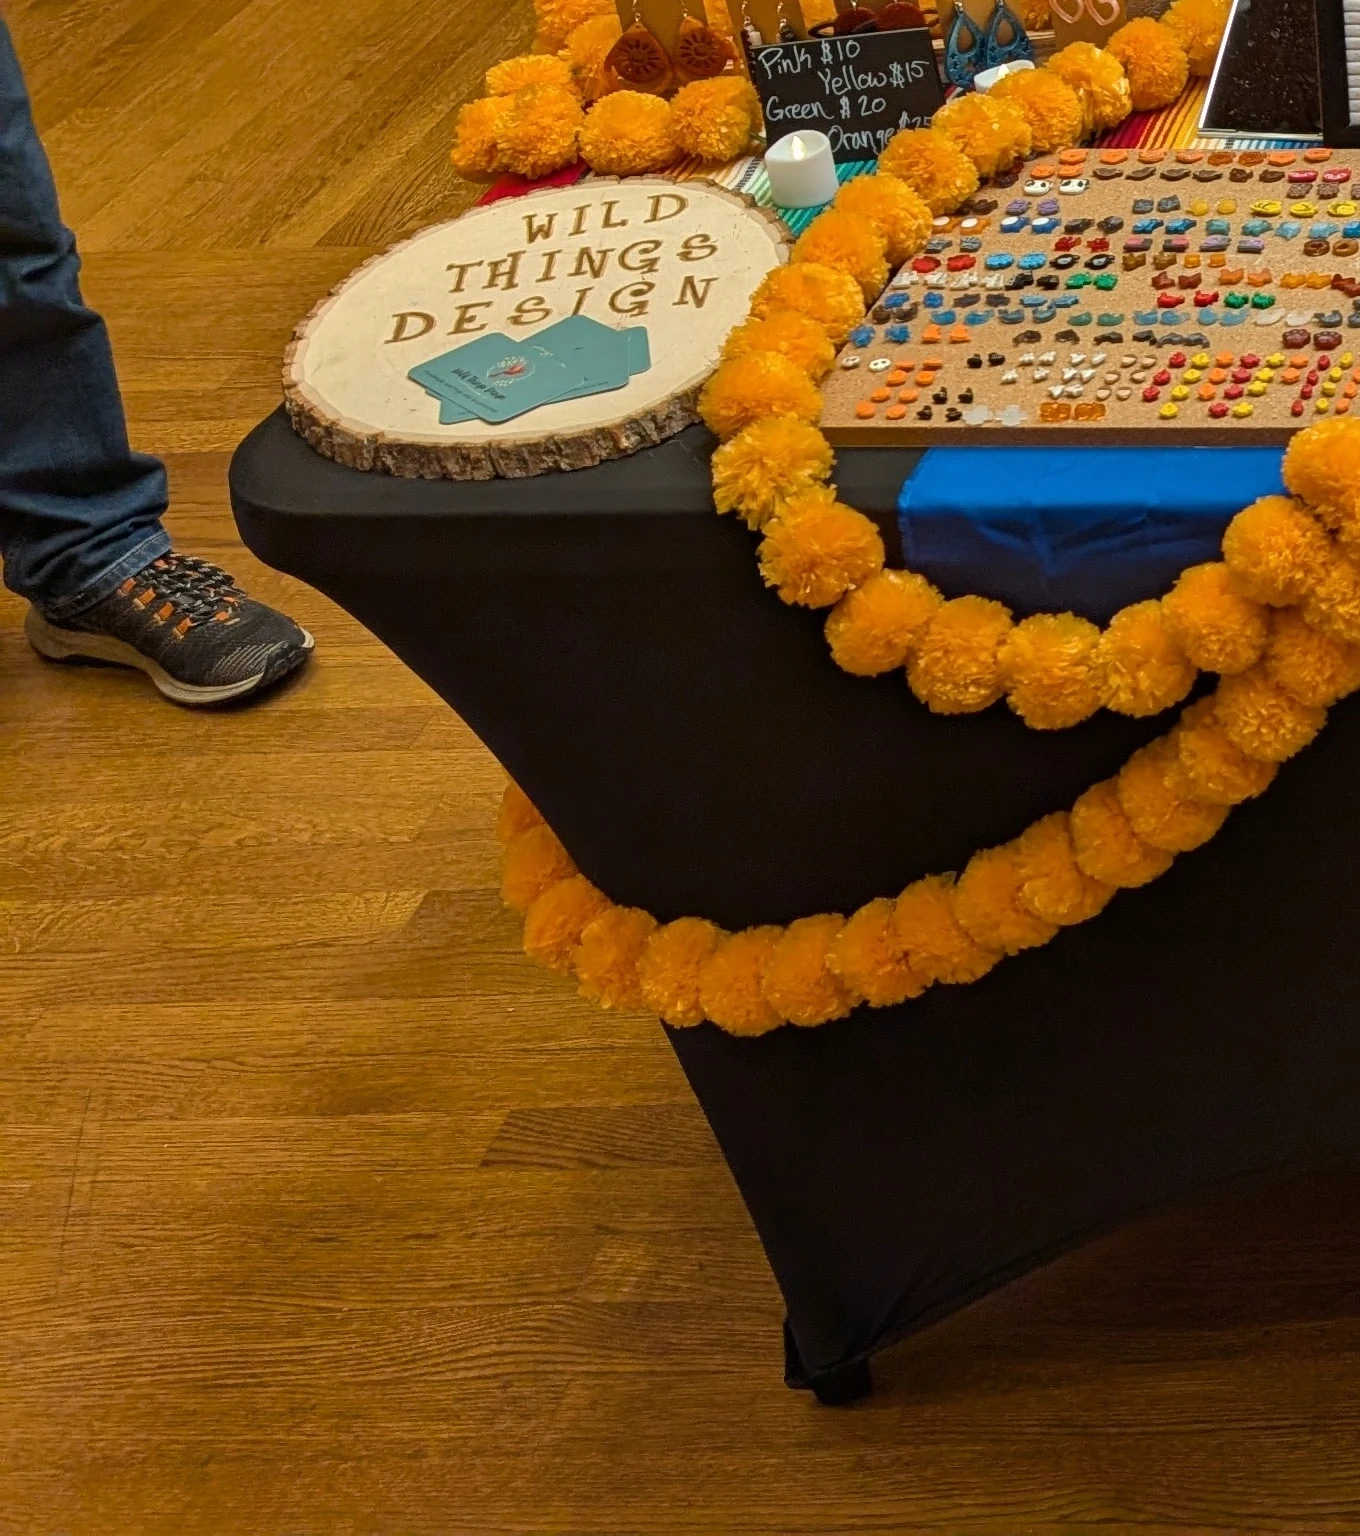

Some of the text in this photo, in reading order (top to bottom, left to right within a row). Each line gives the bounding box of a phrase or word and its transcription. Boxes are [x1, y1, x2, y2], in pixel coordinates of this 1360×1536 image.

[758, 39, 861, 80] Pink $10
[817, 60, 930, 96] Yellow $15
[765, 94, 887, 122] Green $20
[827, 124, 896, 156] Orange
[522, 192, 690, 245] WILD
[445, 232, 719, 295] THINGS
[384, 274, 720, 346] DESIGN
